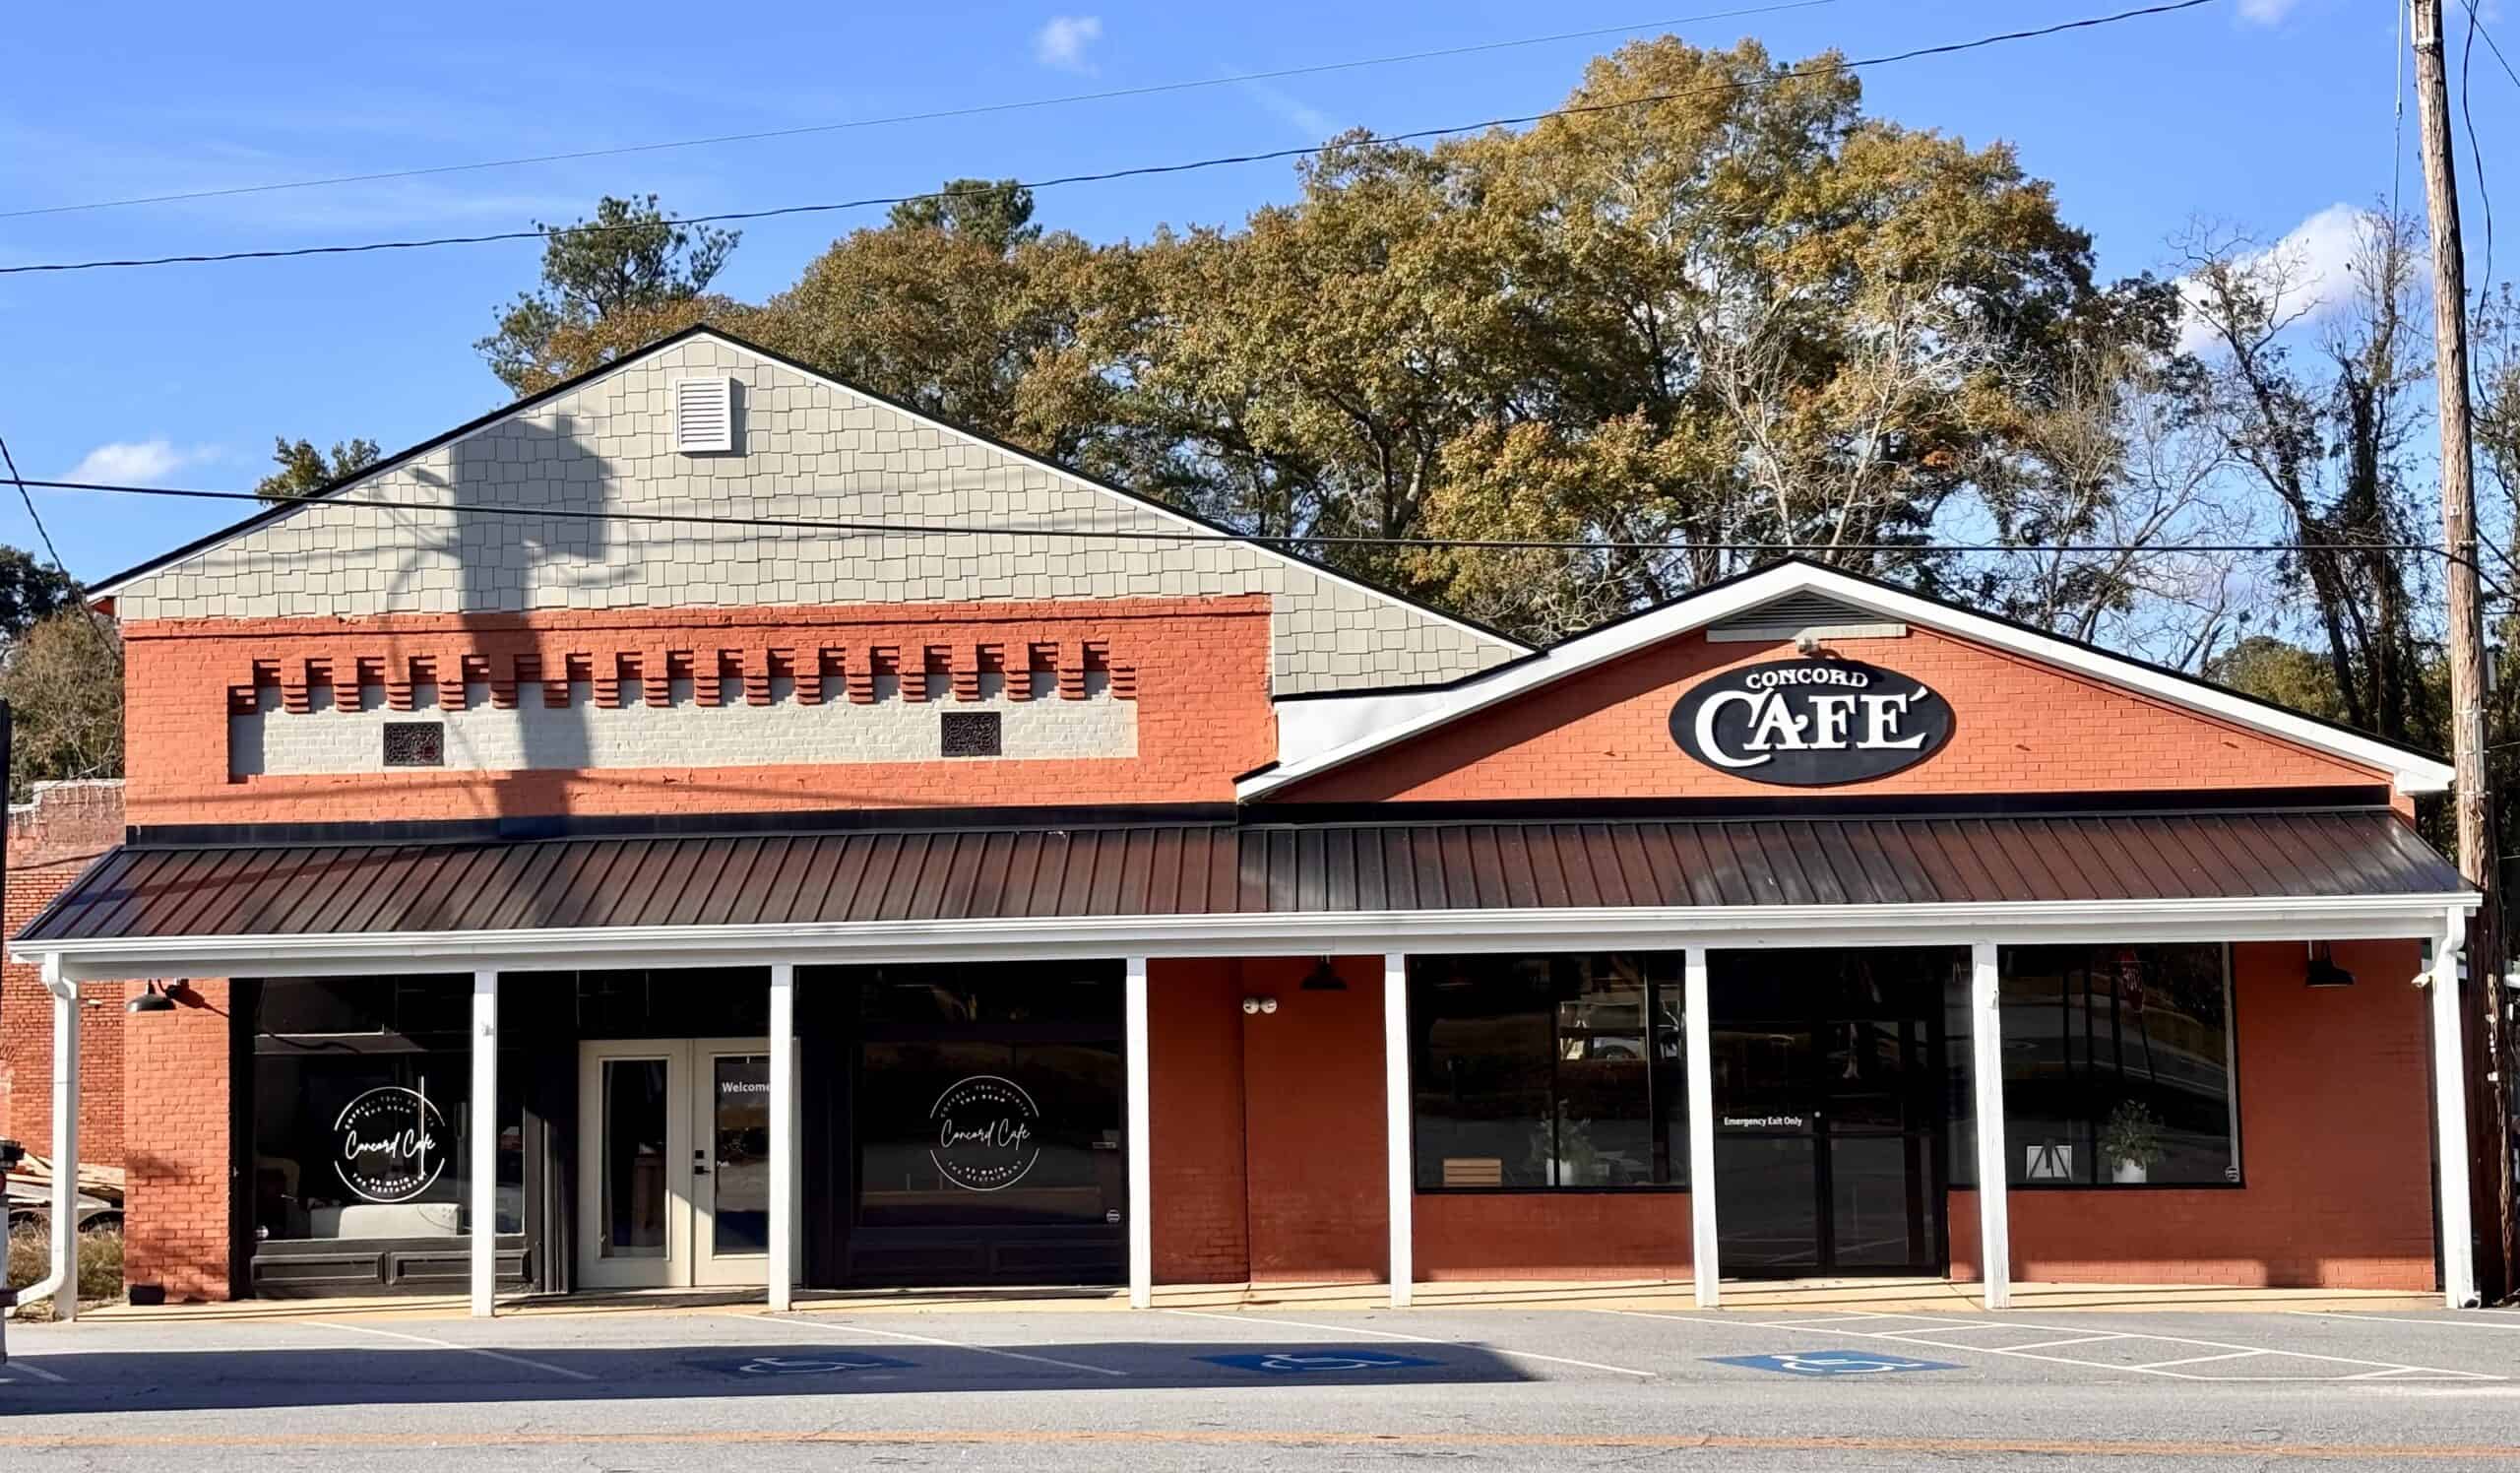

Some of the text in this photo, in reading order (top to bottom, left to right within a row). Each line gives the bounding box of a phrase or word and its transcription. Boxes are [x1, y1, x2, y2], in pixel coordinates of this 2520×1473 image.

[1745, 668, 1869, 689] CONCORD
[941, 1118, 1031, 1151] Concord Cafe
[1724, 1116, 1802, 1127] Emergency Exit Only
[345, 1129, 401, 1160] Concord
